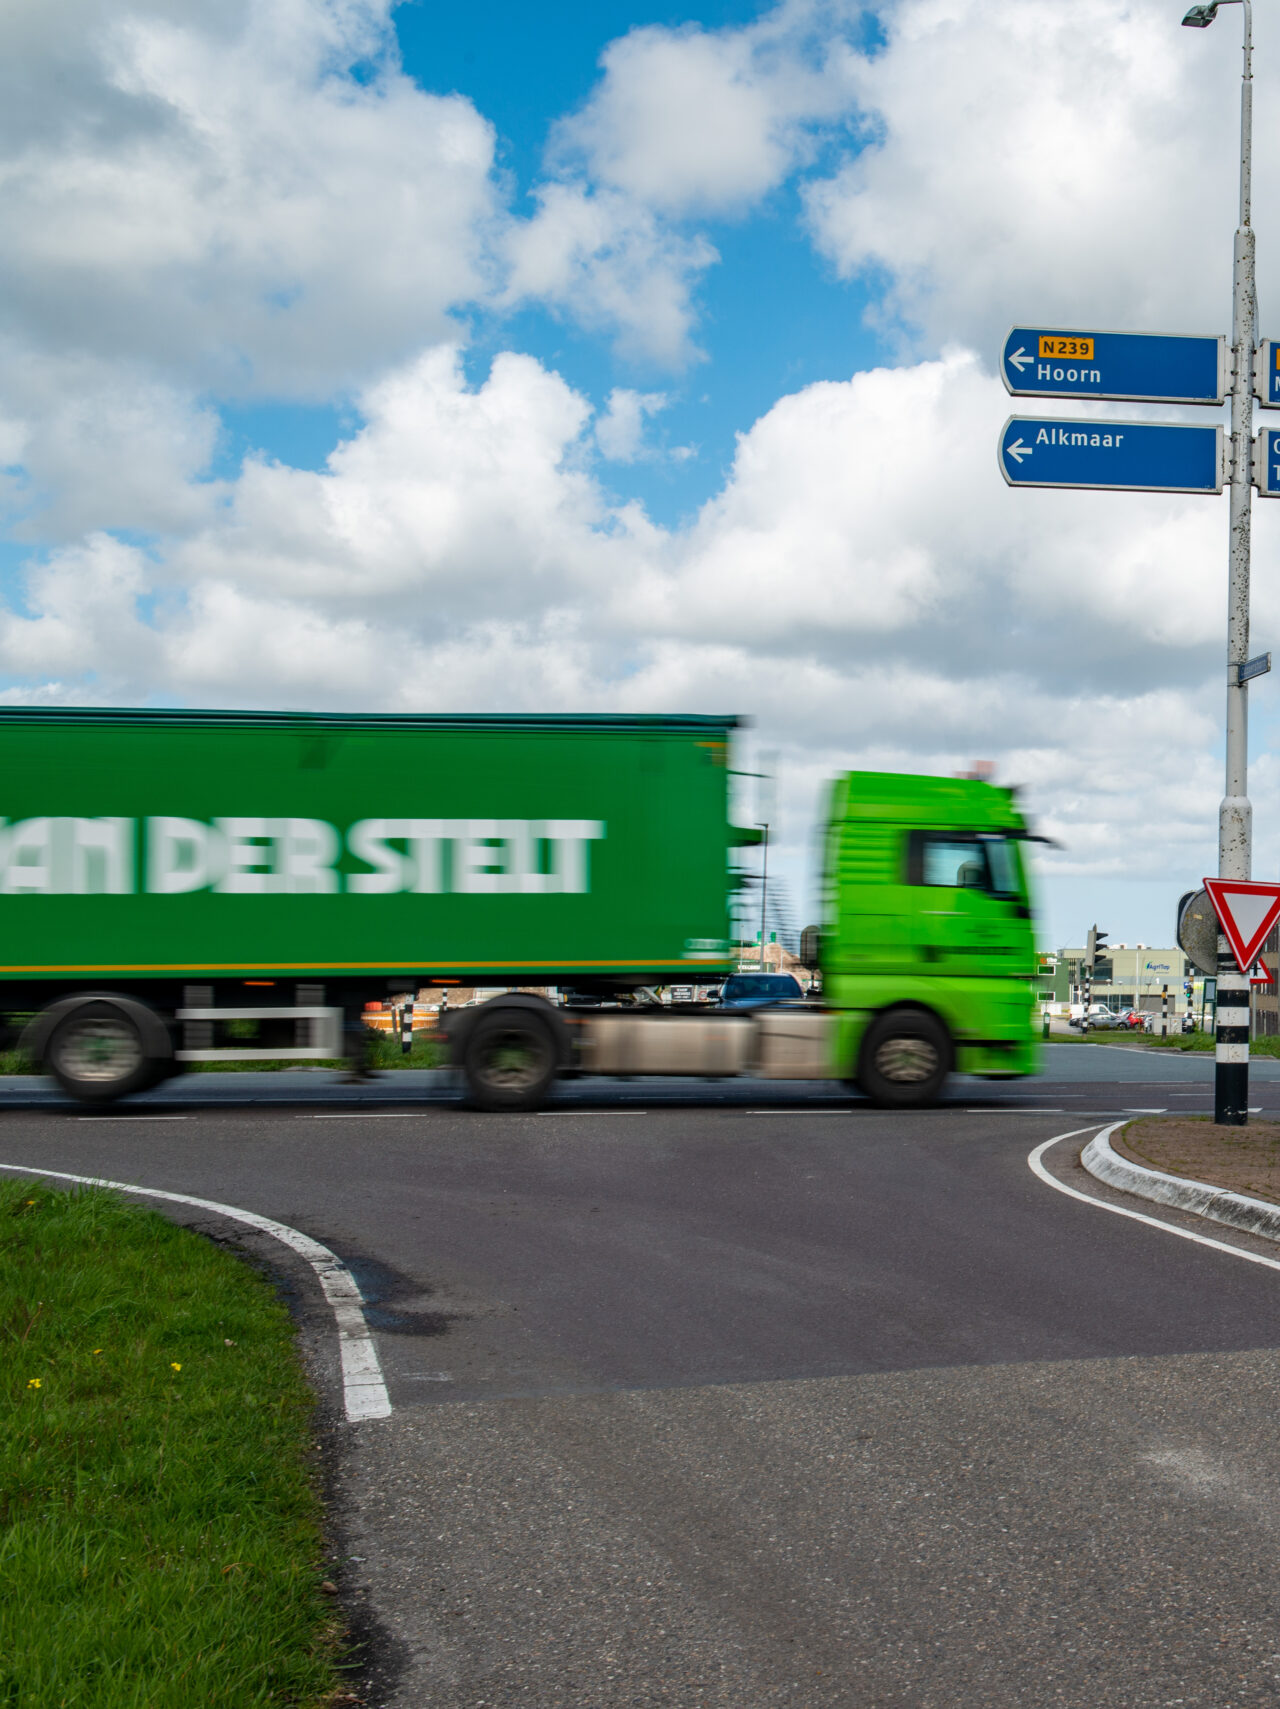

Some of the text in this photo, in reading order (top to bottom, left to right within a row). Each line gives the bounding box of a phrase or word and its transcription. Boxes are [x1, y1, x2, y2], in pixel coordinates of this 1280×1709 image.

[1037, 364, 1101, 383] Hoorn
[1035, 428, 1124, 448] Alkmaar
[143, 816, 343, 893] DER
[345, 818, 607, 893] STELT
